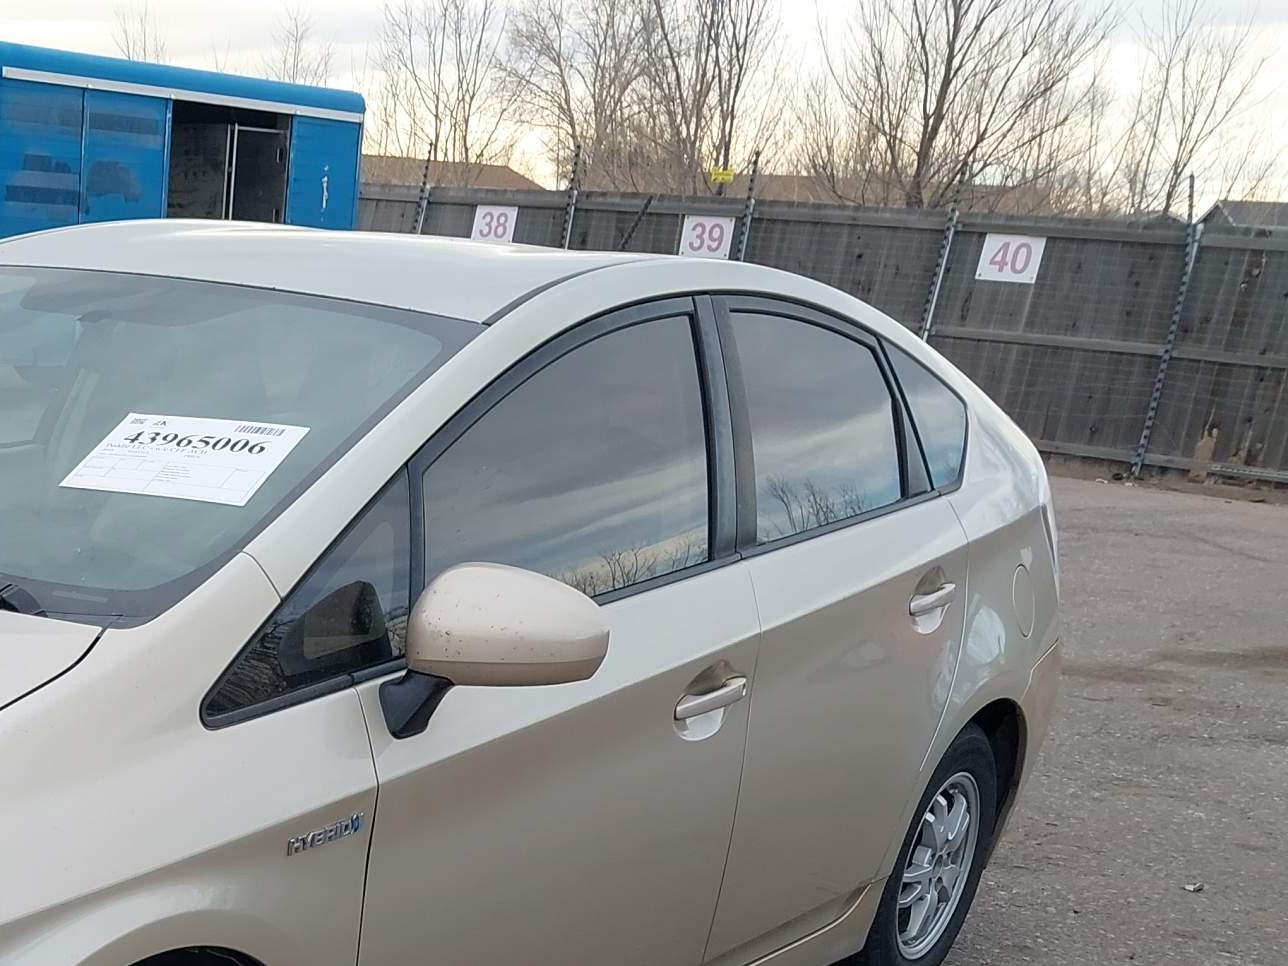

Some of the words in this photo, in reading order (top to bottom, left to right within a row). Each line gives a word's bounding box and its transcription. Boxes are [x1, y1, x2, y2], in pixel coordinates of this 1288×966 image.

[479, 212, 508, 238] 38
[689, 222, 725, 252] 39
[989, 241, 1033, 275] 40
[124, 431, 272, 455] 43965006
[287, 820, 352, 857] HYBRID
